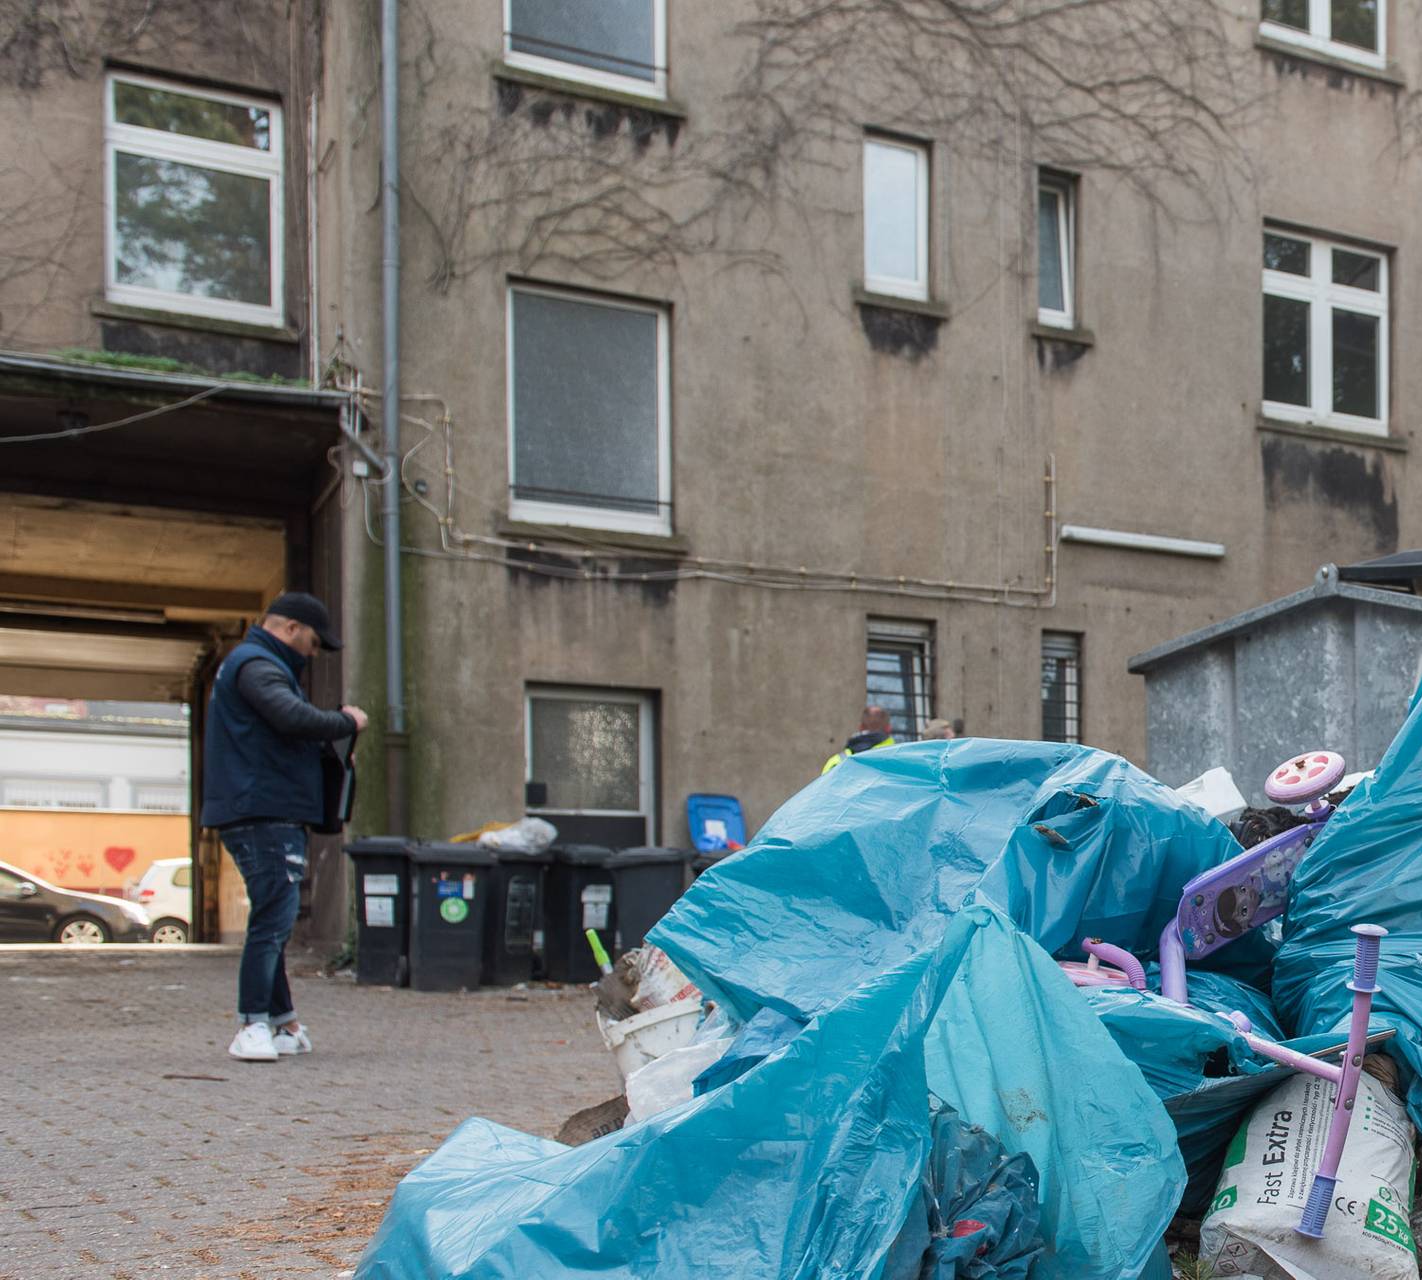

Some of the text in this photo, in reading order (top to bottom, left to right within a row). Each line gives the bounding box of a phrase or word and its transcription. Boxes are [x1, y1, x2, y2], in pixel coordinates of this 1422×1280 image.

[1257, 1110, 1293, 1205] Fast Extra
[1335, 1197, 1357, 1216] CE
